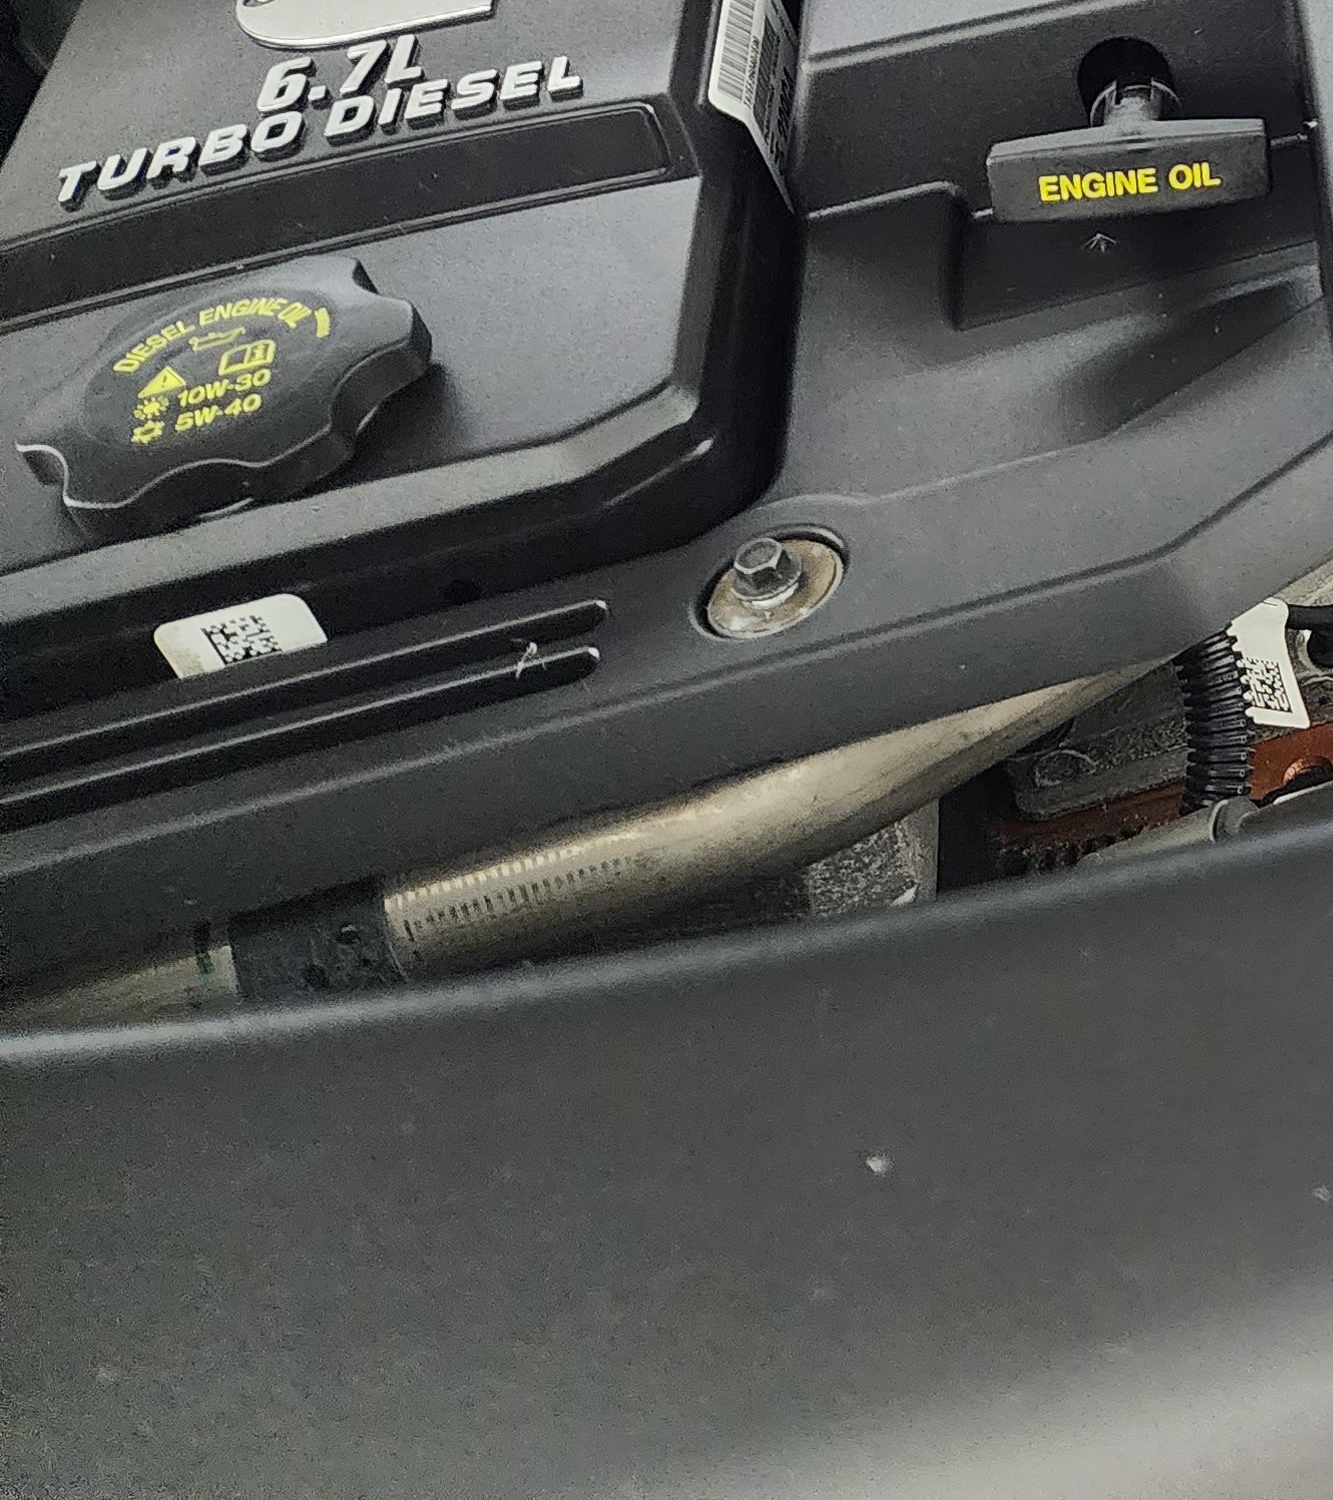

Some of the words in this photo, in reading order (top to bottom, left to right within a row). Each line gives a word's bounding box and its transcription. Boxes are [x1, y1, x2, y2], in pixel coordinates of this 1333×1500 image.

[257, 34, 425, 113] 6.7L
[56, 110, 306, 208] TURBO
[323, 55, 584, 142] DIESEL
[1038, 167, 1158, 203] ENGINE
[1168, 161, 1222, 191] OIL
[112, 320, 196, 372] DIESEL
[199, 297, 289, 327] ENGINE
[277, 301, 313, 329] OIL
[174, 393, 262, 432] 5W-40
[177, 368, 272, 408] 10W-30
